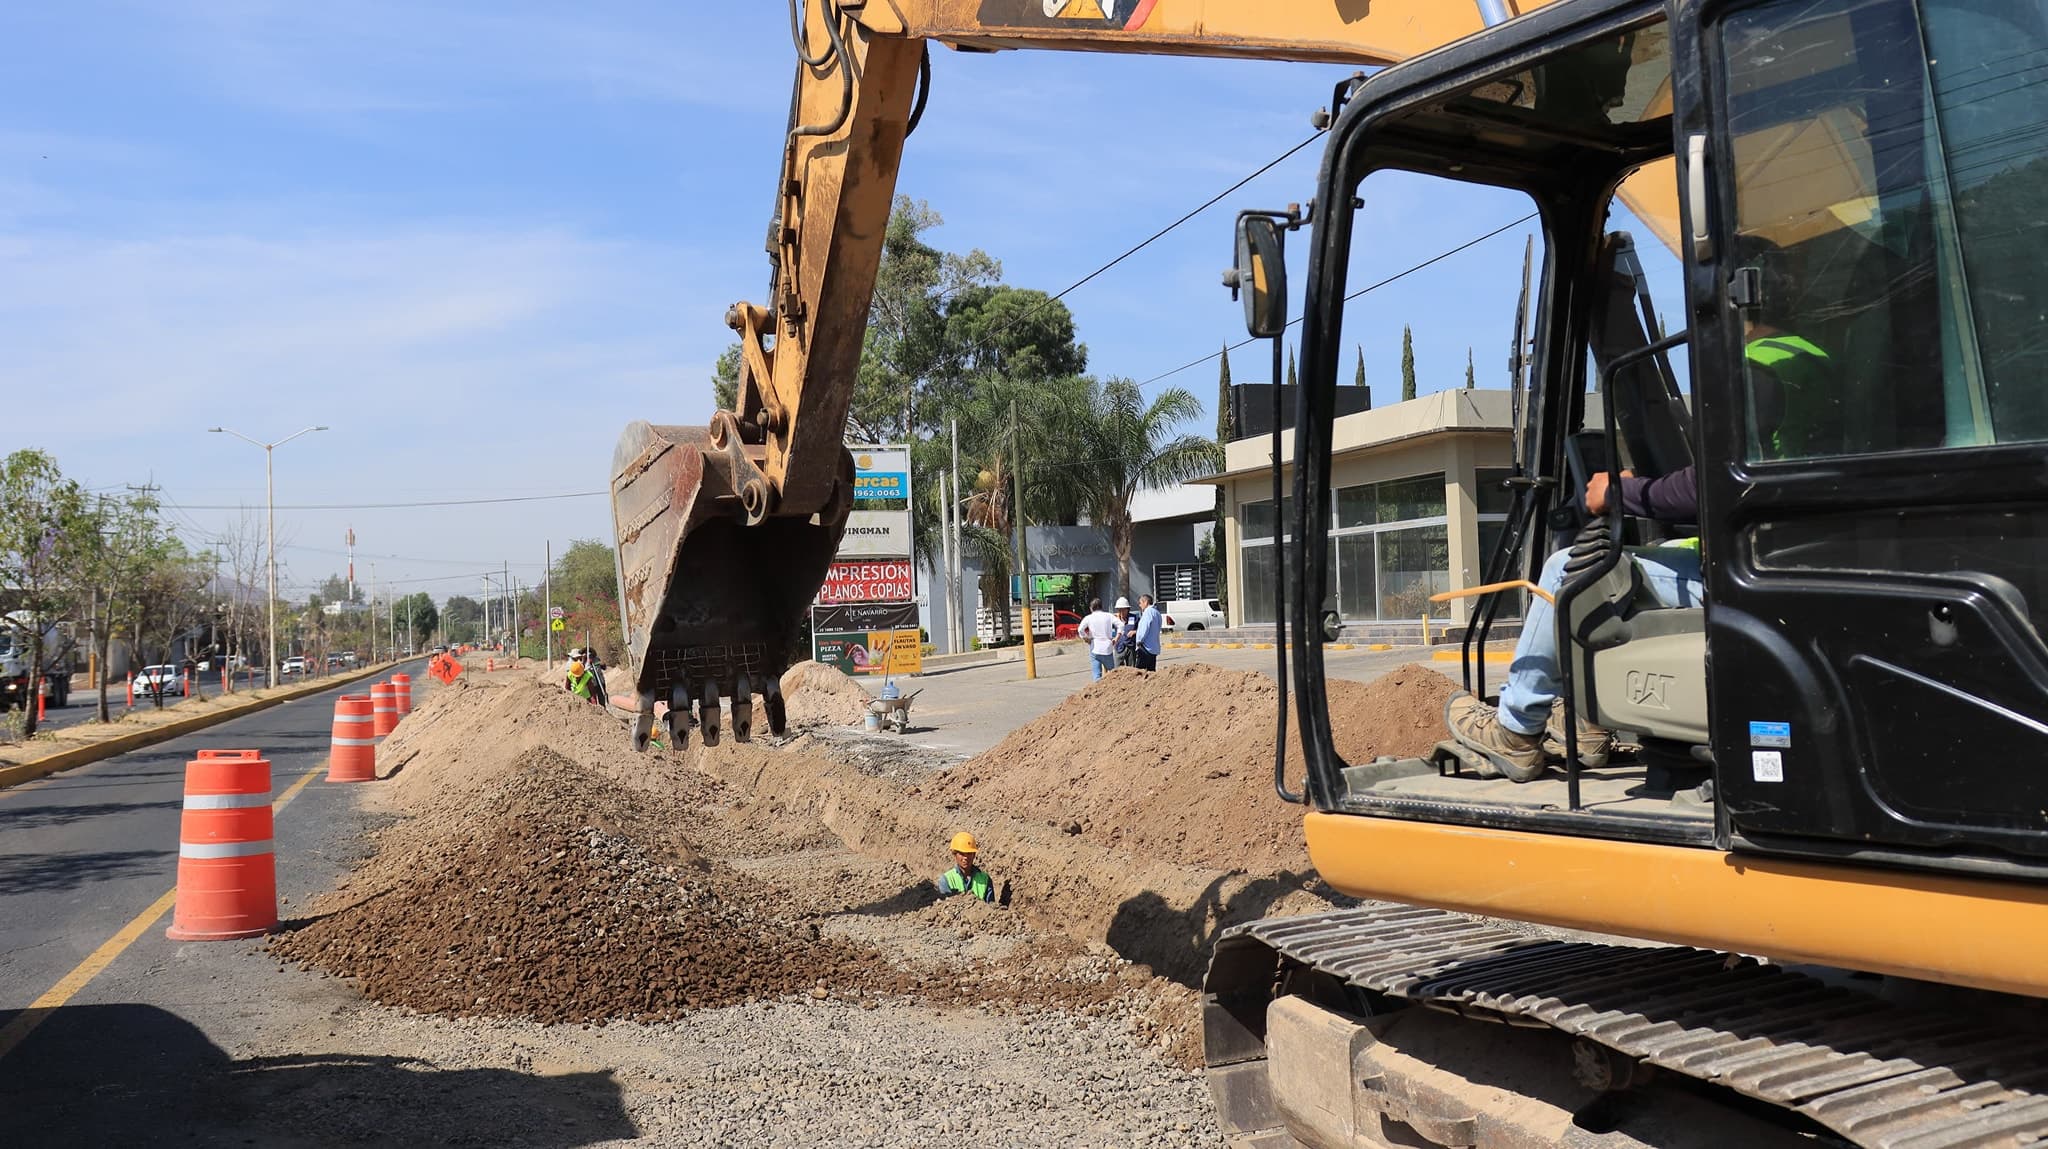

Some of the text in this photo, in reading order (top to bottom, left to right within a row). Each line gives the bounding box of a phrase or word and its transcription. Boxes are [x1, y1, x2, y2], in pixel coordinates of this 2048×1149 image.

[855, 476, 899, 487] ercas
[826, 562, 909, 581] MPRESIÓN
[821, 582, 911, 600] PLANOS COPIAS
[1625, 670, 1677, 709] CAT
